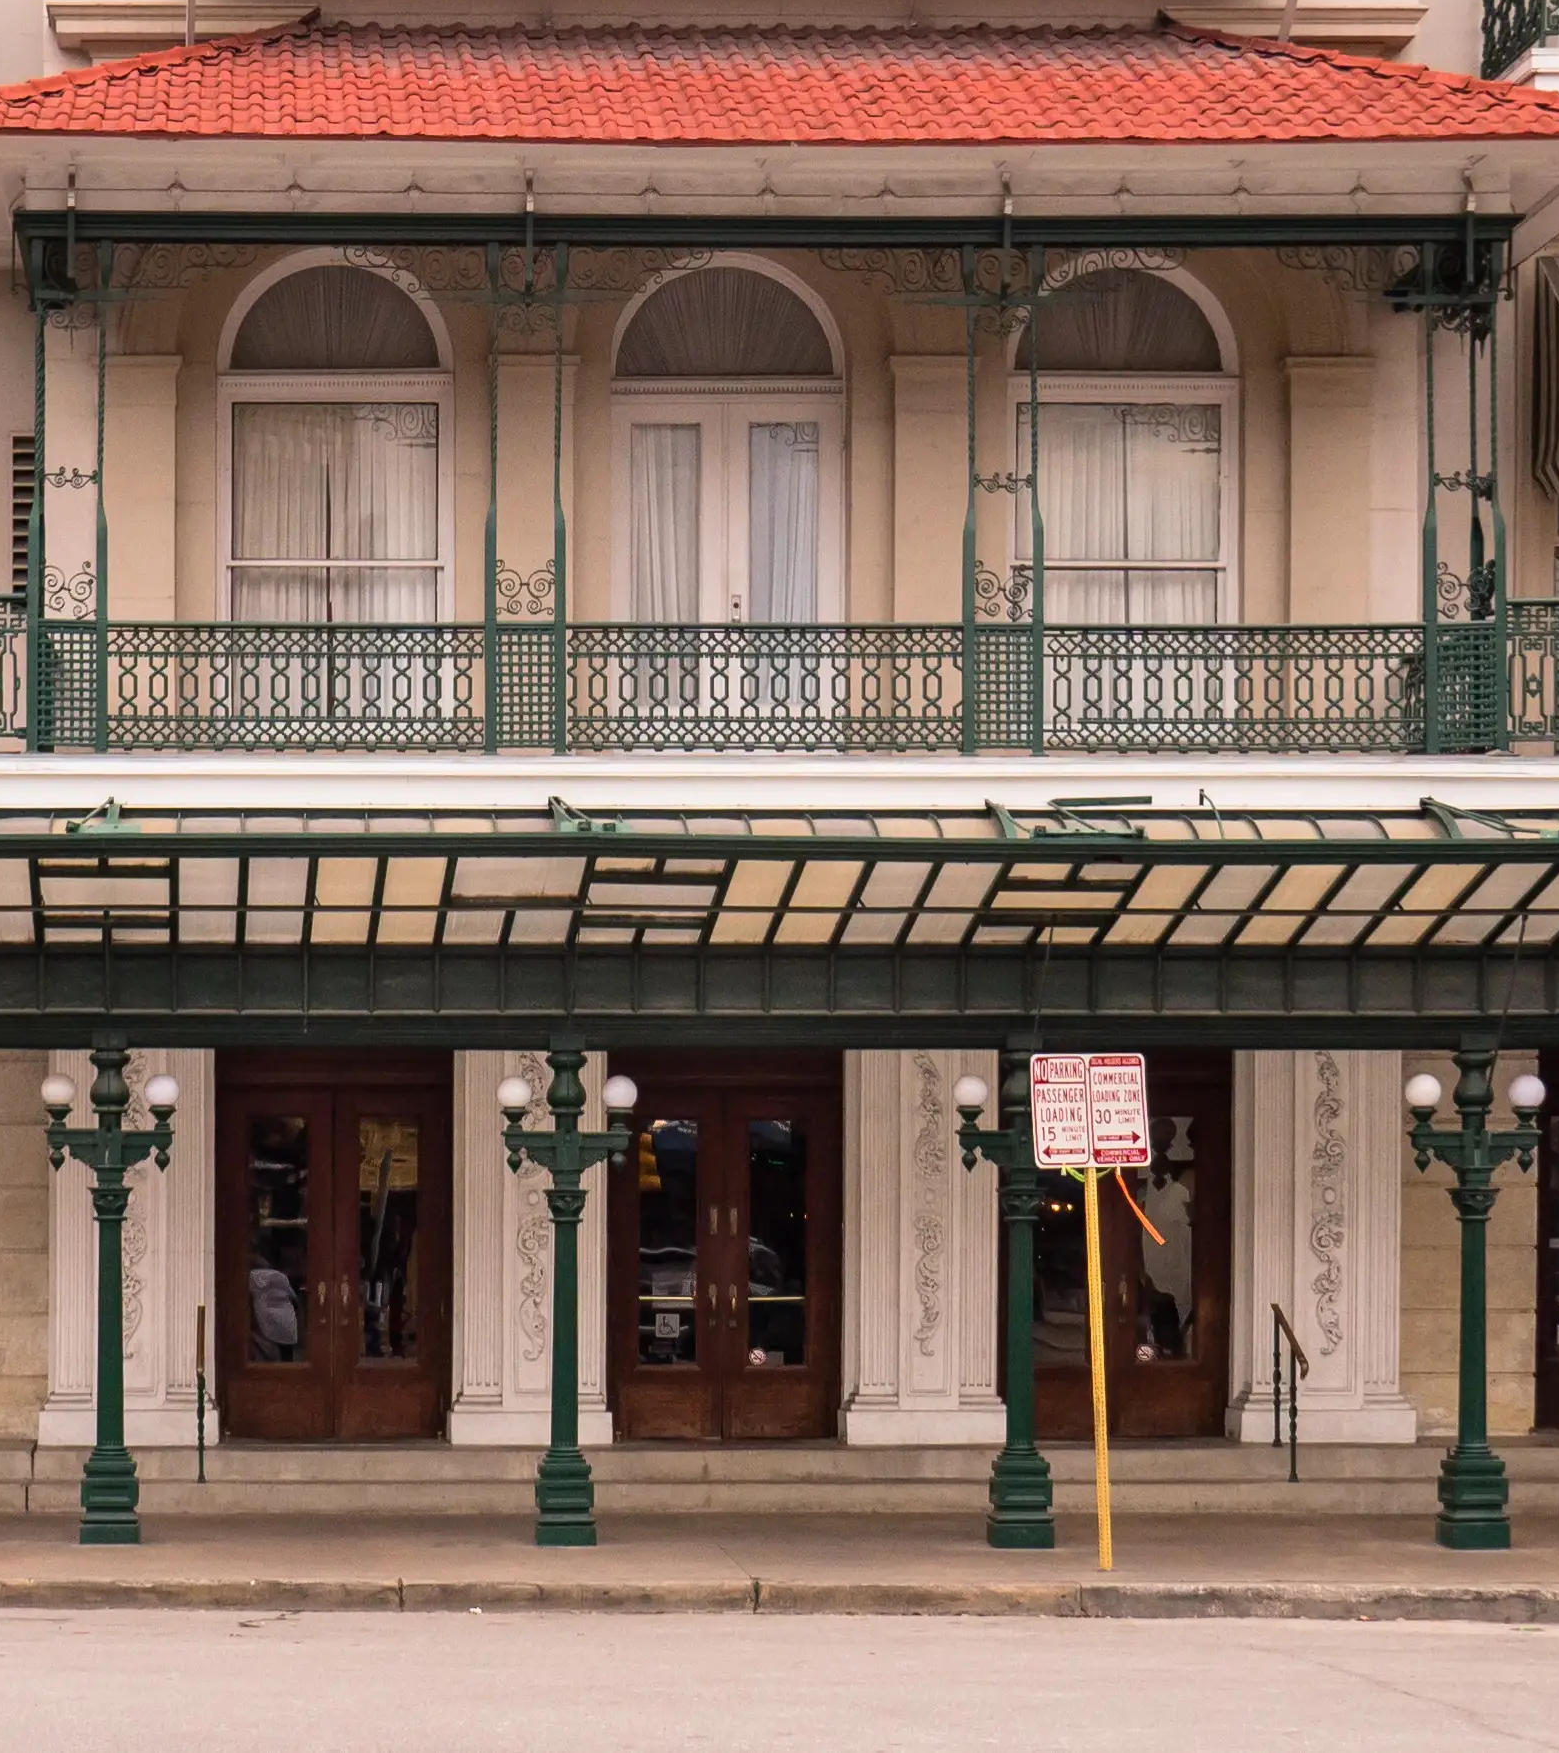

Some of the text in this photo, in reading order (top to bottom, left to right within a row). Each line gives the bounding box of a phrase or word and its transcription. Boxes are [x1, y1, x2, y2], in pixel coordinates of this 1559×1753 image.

[1034, 1058, 1083, 1081] NO PARKING
[1093, 1072, 1139, 1085] COMMERCIAL
[1036, 1088, 1084, 1103] PASSENGER
[1092, 1089, 1141, 1103] LOADING ZONE
[1040, 1106, 1082, 1123] LOADING
[1094, 1108, 1141, 1124] 30 MINUTE
[1118, 1116, 1136, 1124] LIMIT
[1041, 1126, 1057, 1142] 15
[1065, 1134, 1083, 1142] LIMIT
